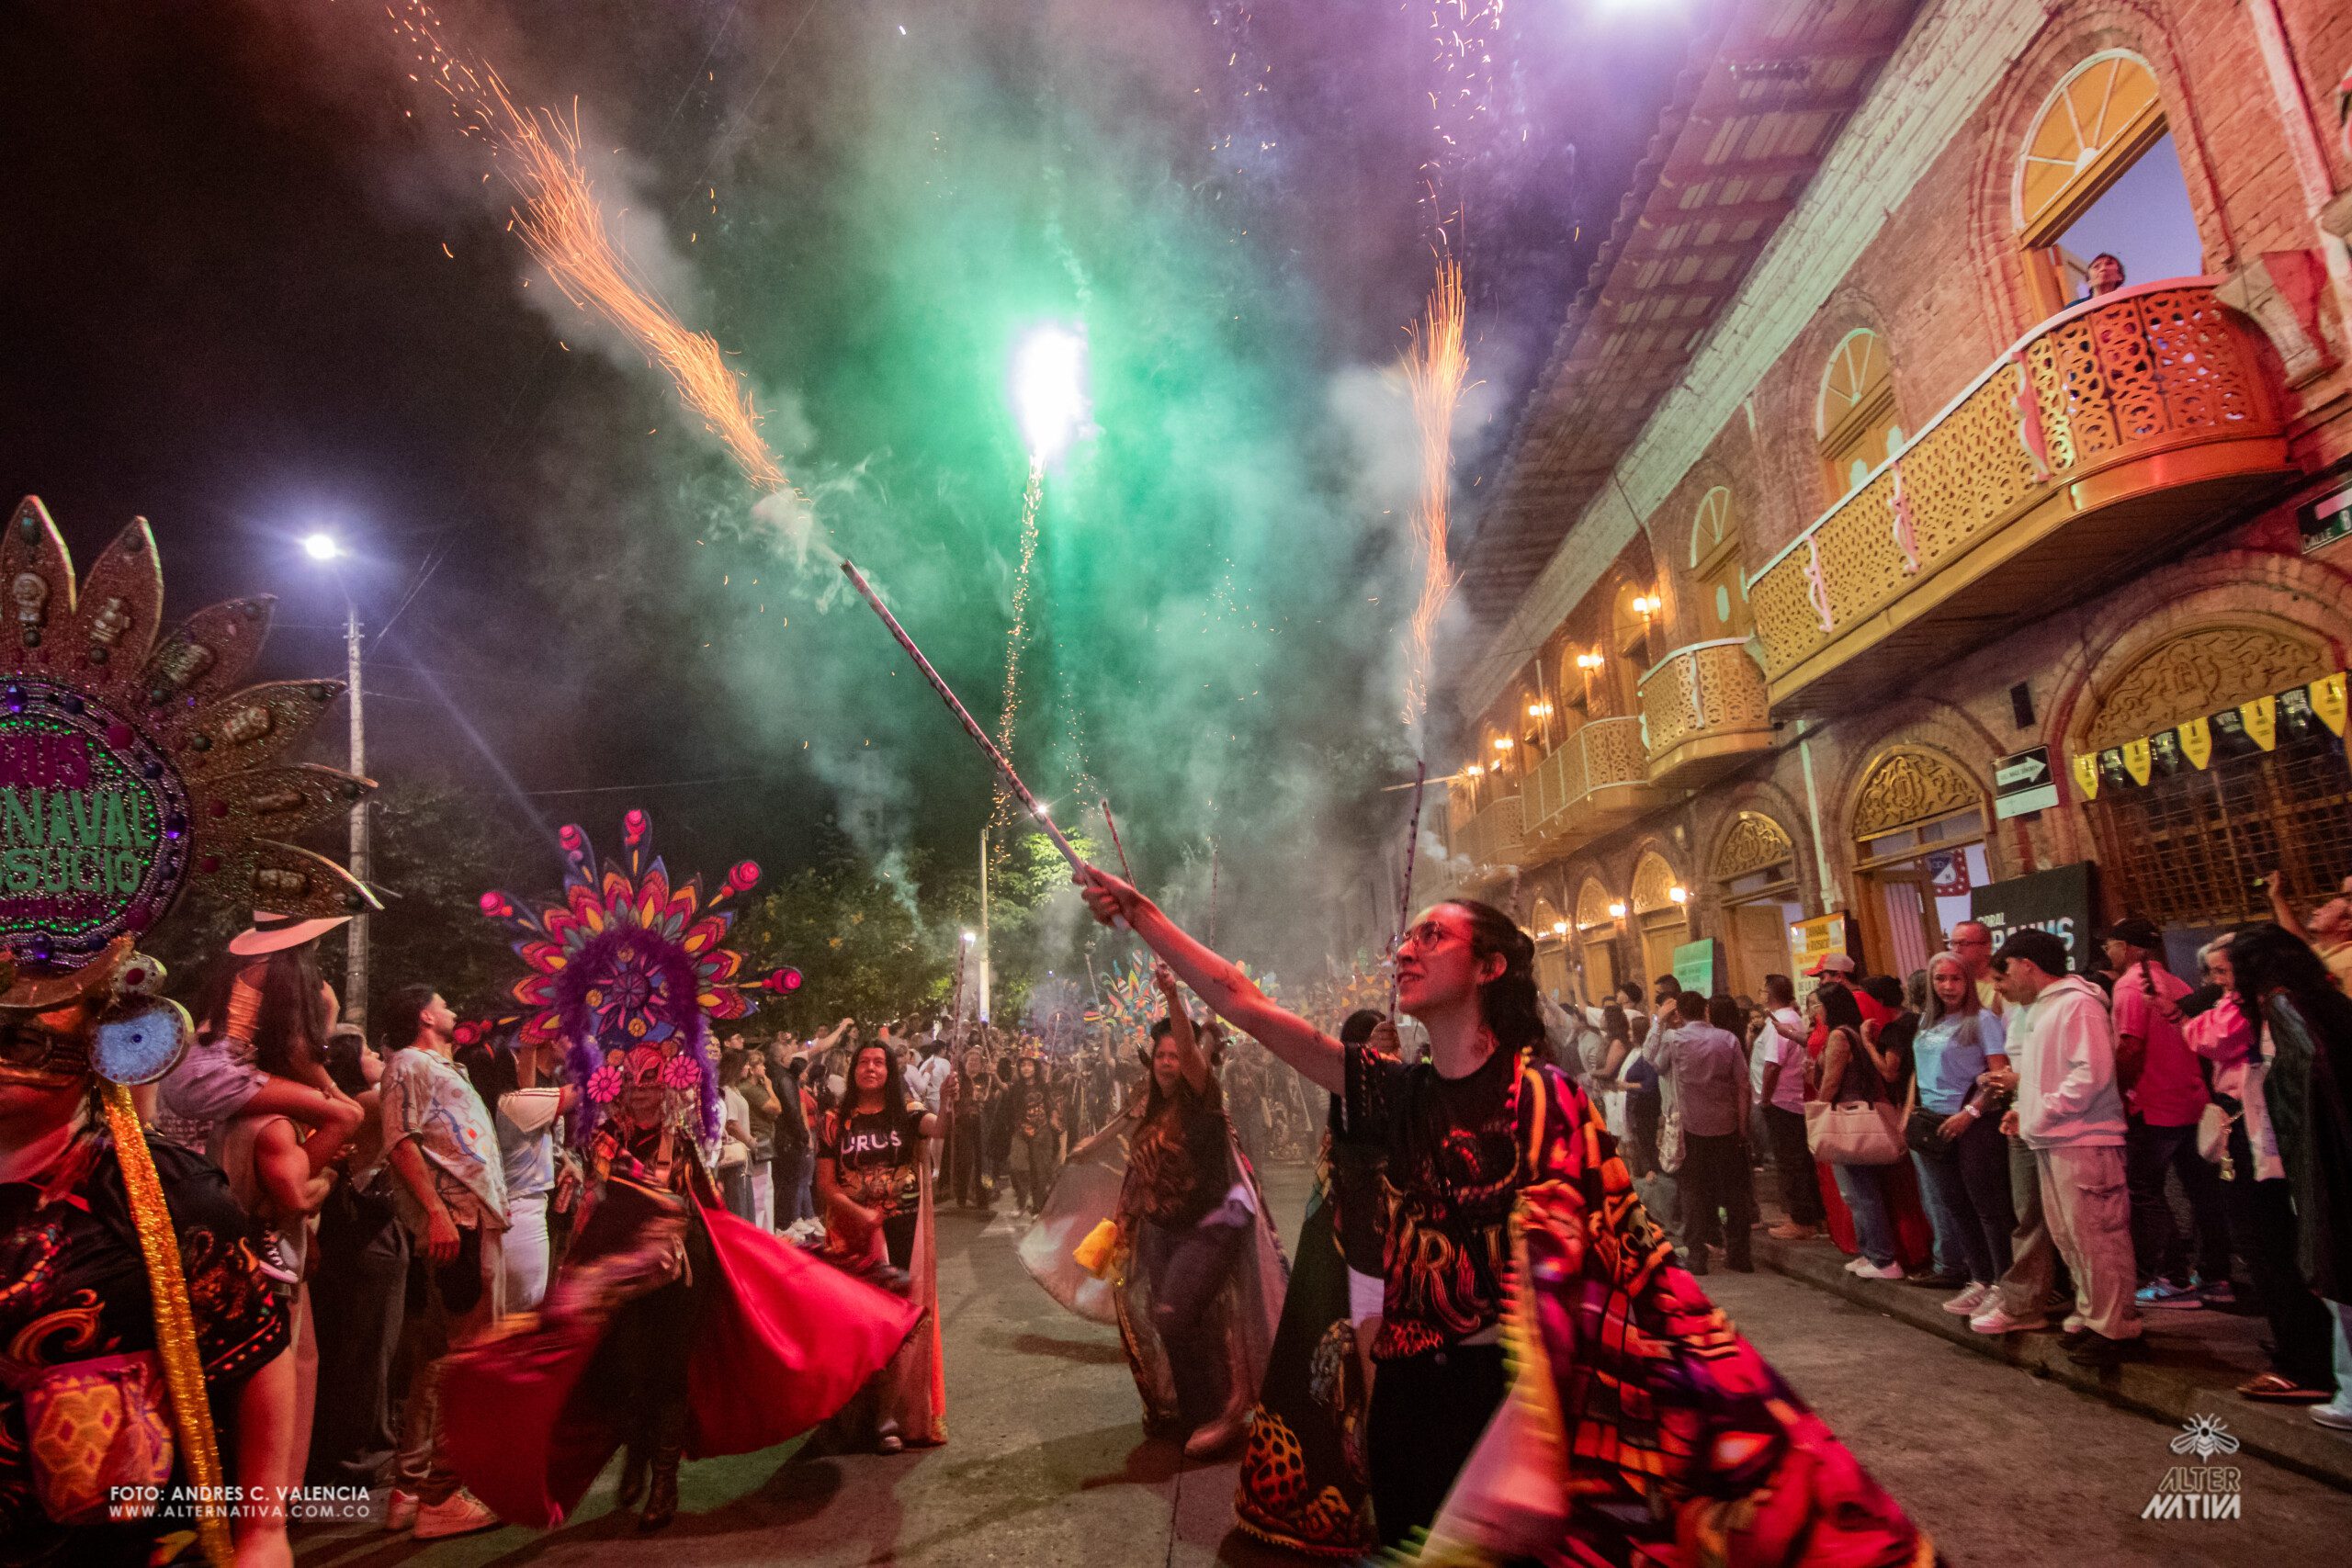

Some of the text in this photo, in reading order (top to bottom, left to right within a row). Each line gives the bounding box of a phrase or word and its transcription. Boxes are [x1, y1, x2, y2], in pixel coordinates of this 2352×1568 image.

[0, 789, 153, 847] NAVAL
[0, 847, 140, 894] SUCIO
[841, 1129, 902, 1155] URUS
[1380, 1181, 1505, 1334] URU
